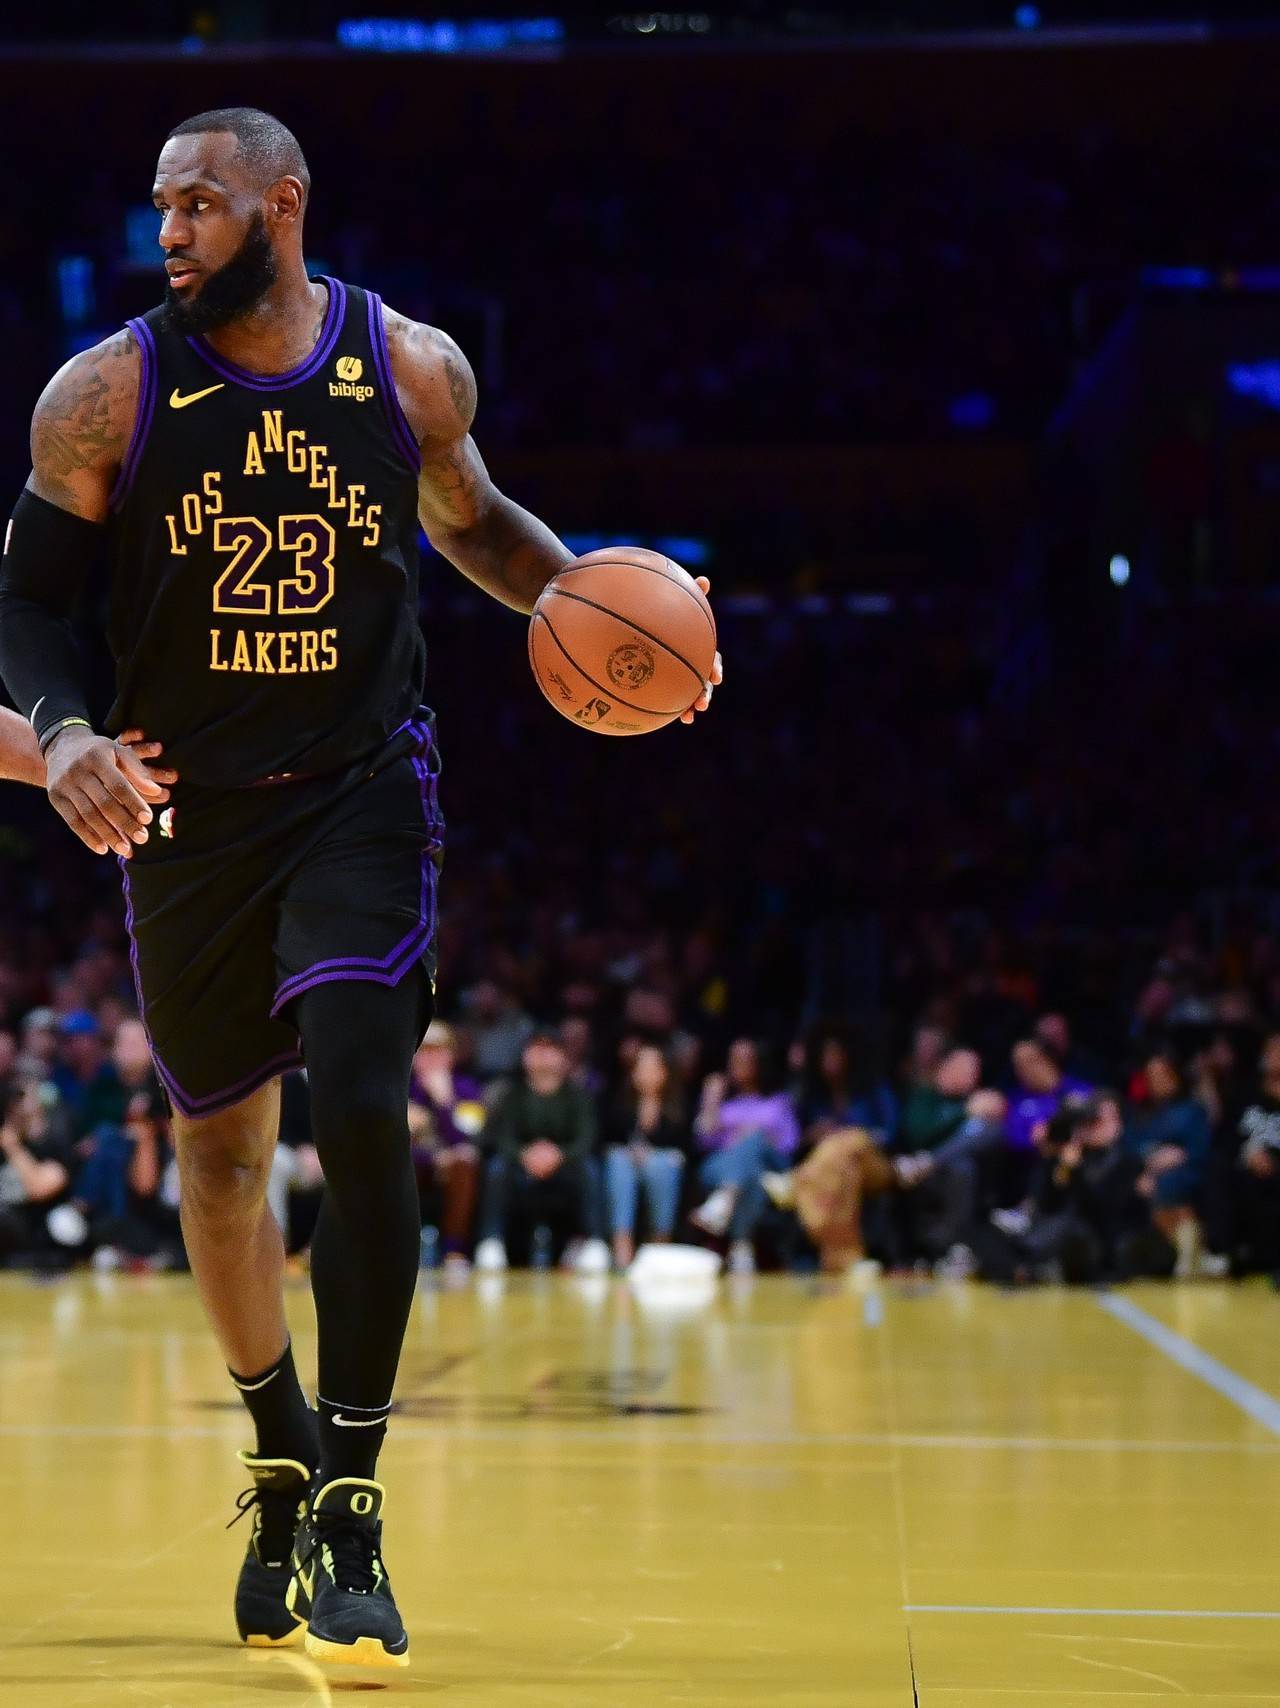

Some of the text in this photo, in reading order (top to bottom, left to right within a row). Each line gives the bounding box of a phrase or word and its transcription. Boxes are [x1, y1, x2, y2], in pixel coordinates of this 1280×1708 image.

[328, 382, 375, 402] bibigo
[165, 410, 382, 555] LOS ANGELES
[213, 514, 336, 615] 23
[209, 628, 337, 674] LAKERS
